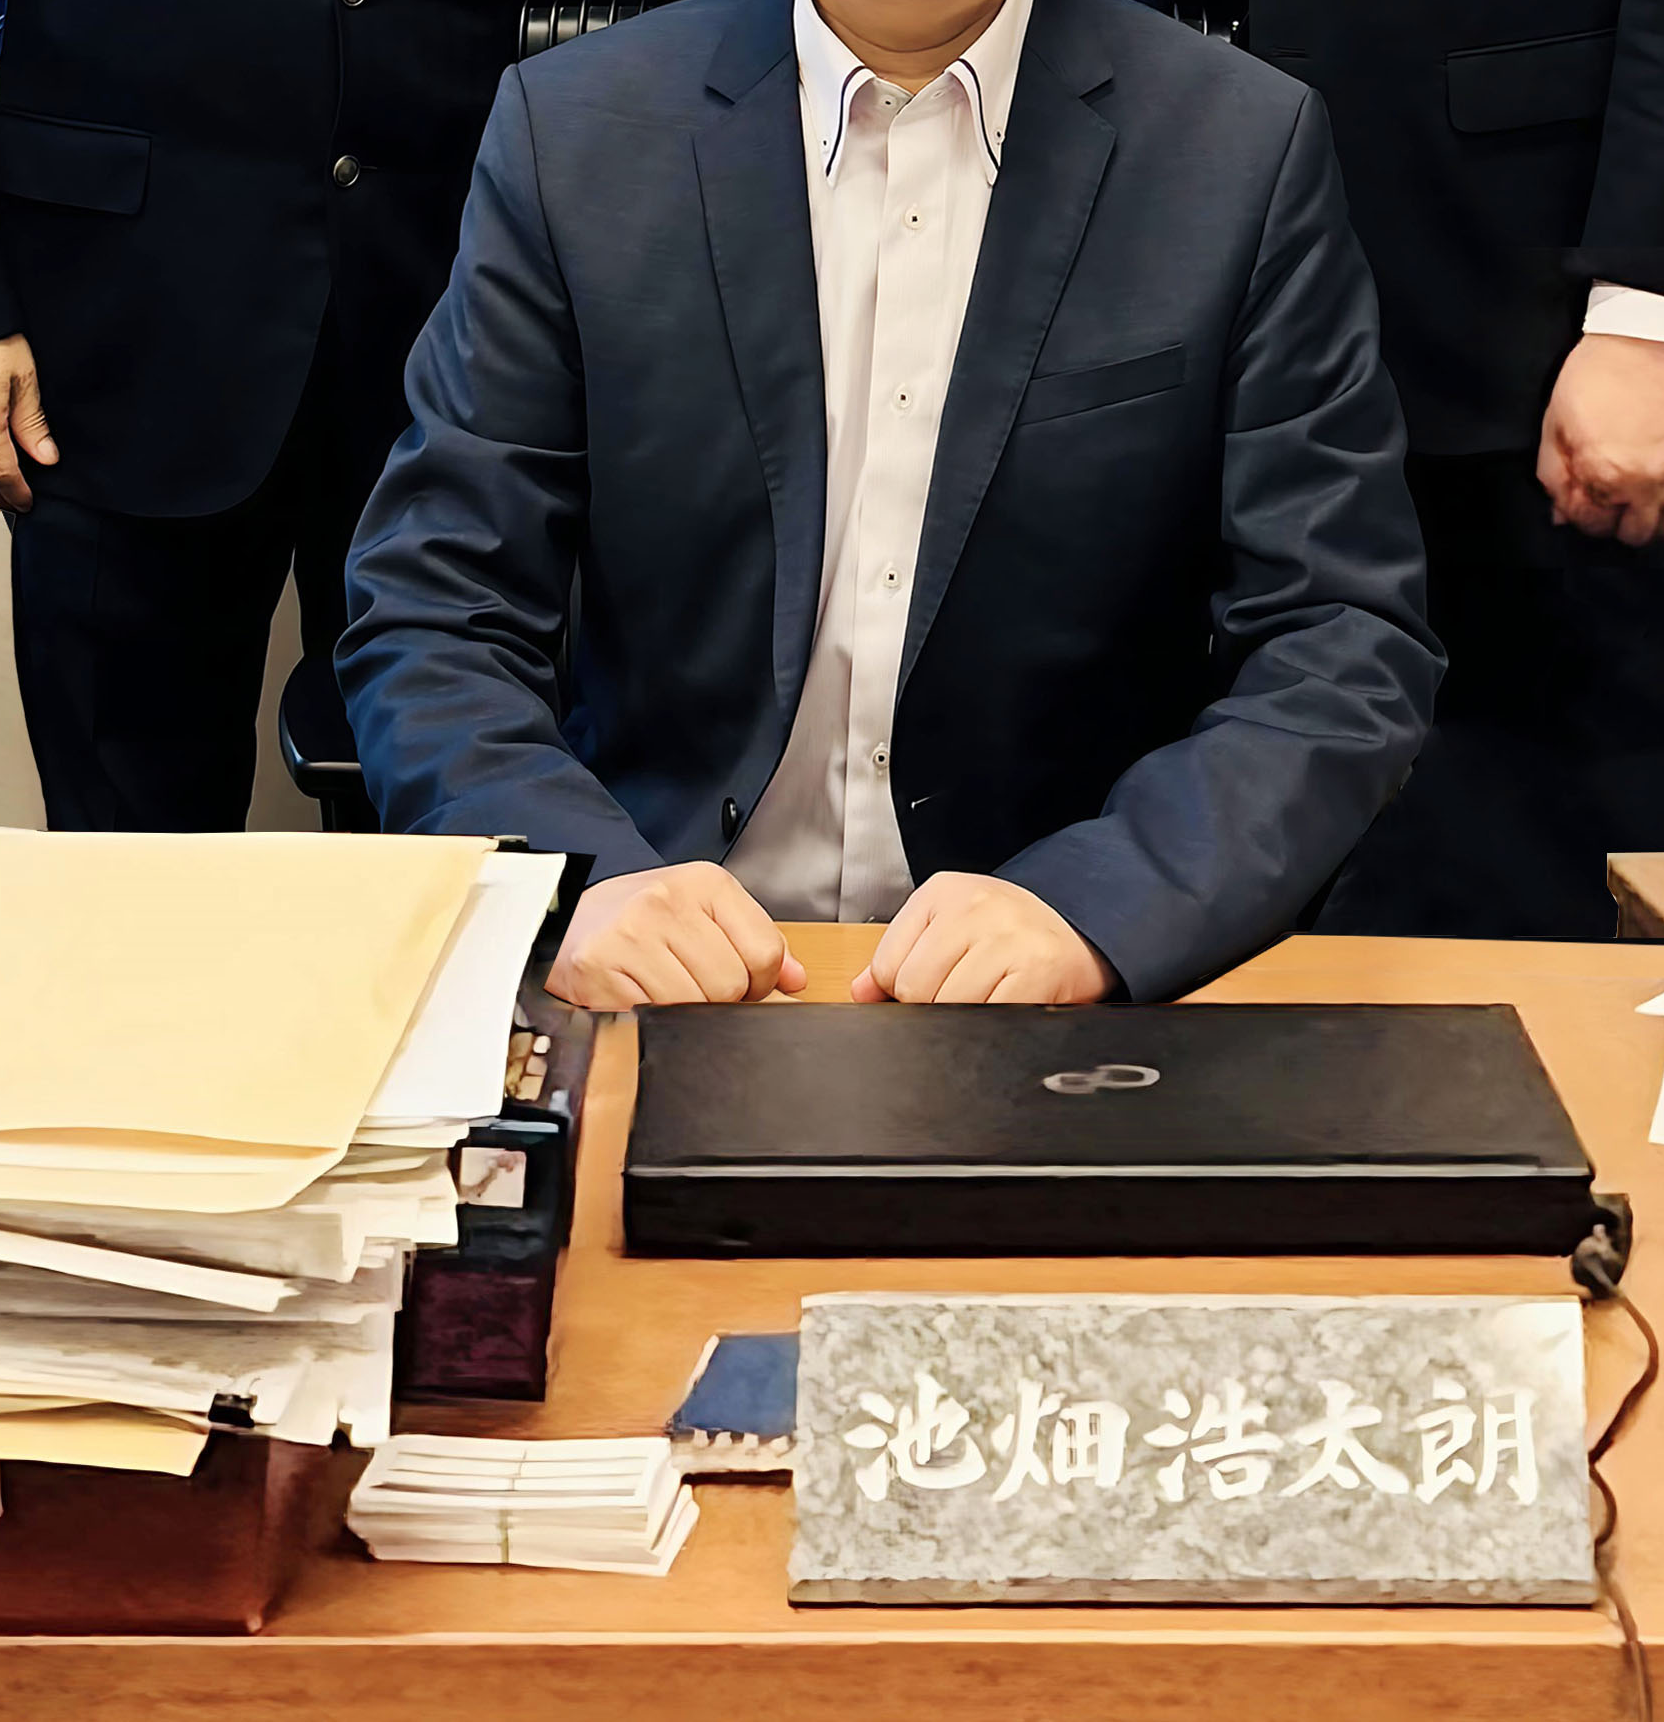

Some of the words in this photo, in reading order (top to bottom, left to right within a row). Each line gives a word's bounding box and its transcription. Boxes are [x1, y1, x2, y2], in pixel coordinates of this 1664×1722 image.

[843, 1373, 1541, 1506] 池畑浩太朗
